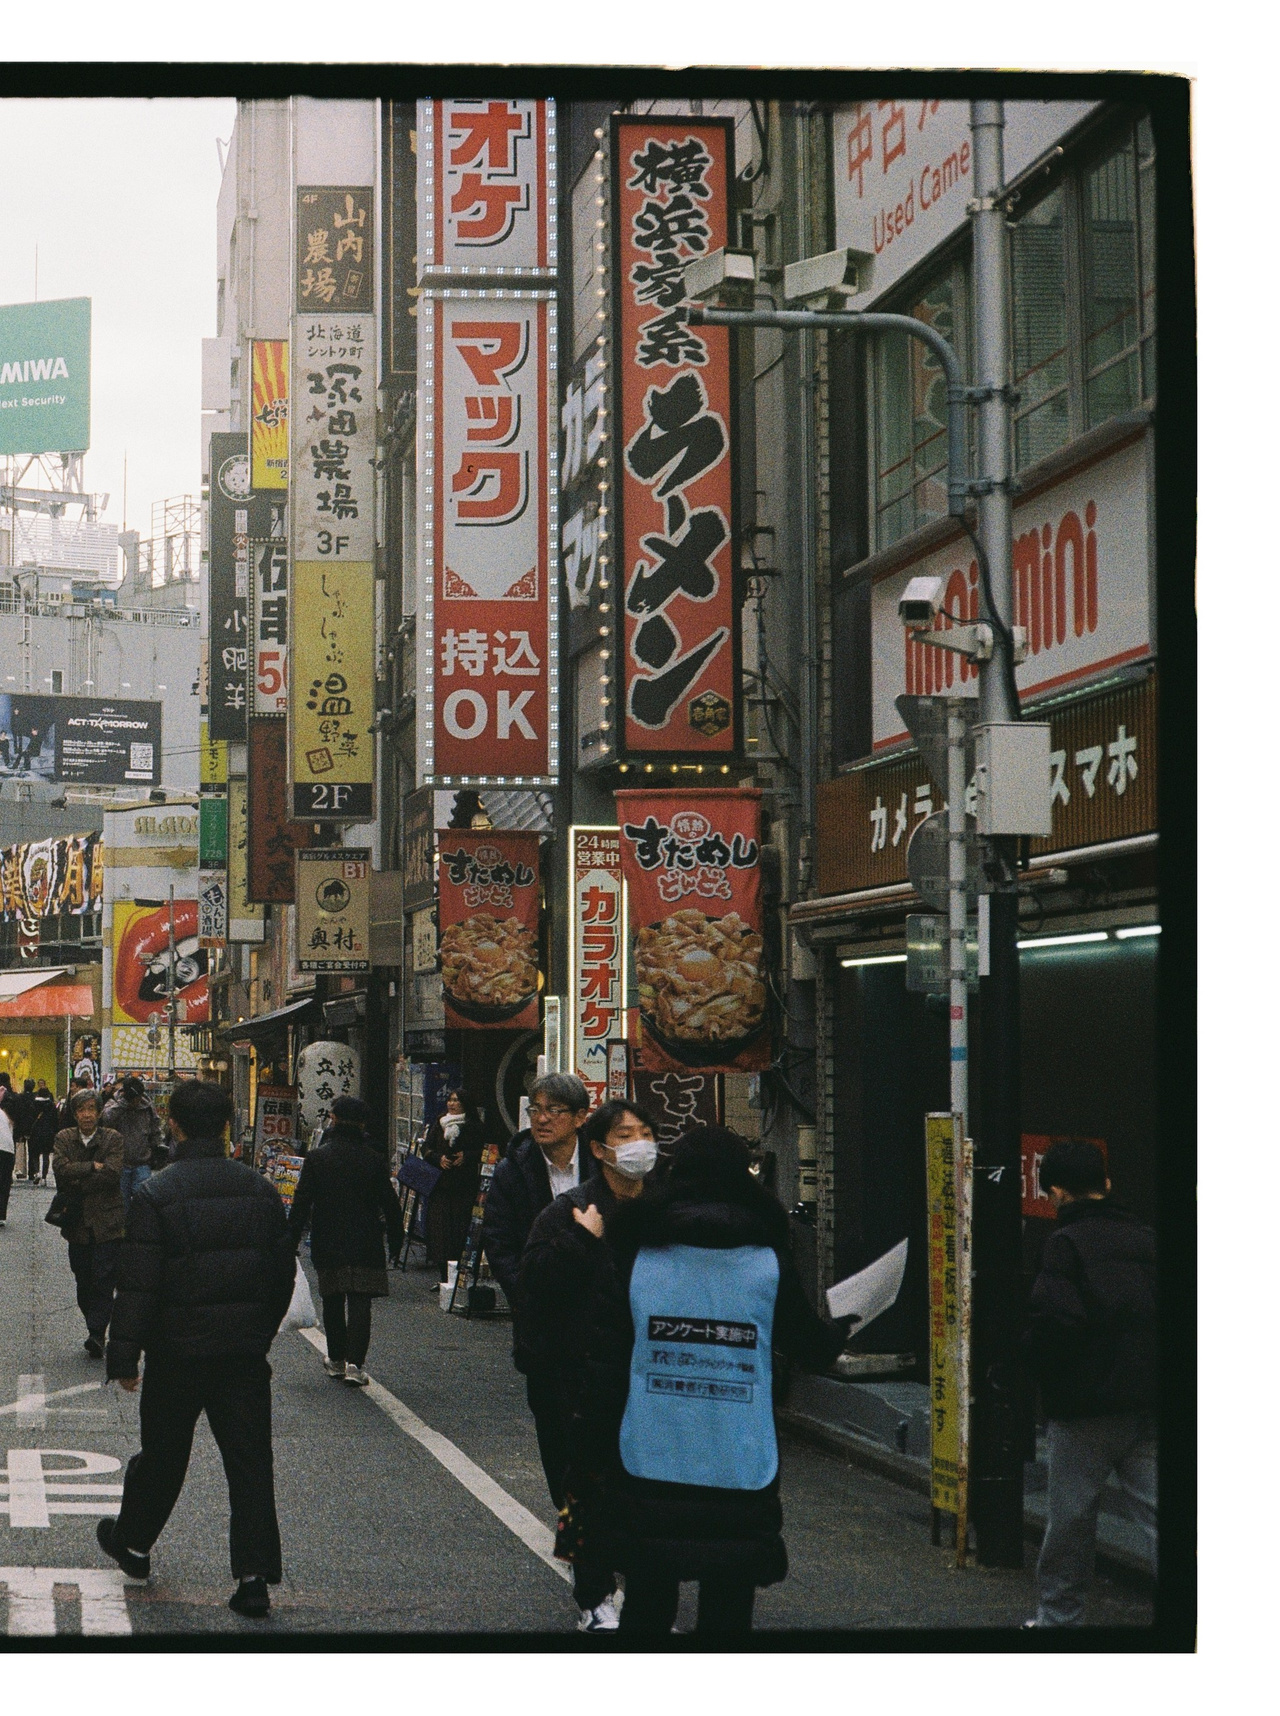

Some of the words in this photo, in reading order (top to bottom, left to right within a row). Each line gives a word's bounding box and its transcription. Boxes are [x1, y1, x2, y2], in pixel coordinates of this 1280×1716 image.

[302, 194, 318, 204] 4F
[871, 181, 916, 254] Used
[920, 141, 970, 211] Came
[334, 194, 366, 263] 山内
[301, 228, 337, 302] 農場
[306, 324, 364, 342] 北海道
[0, 357, 69, 384] MIWA
[21, 395, 66, 407] Security
[451, 320, 531, 527] マック
[317, 530, 350, 554] 3F
[441, 628, 541, 676] 持込
[258, 651, 288, 696] 5
[306, 673, 359, 758] 温野菜
[443, 689, 539, 740] OK
[1049, 724, 1139, 806] スマホ
[311, 785, 353, 809] 2F
[344, 863, 365, 878] B1
[577, 852, 620, 866] 営業中
[308, 926, 356, 951] 奥村
[581, 884, 621, 1040] カラオケ
[337, 1058, 356, 1095] 焼き
[651, 1320, 756, 1343] アンケート実施中
